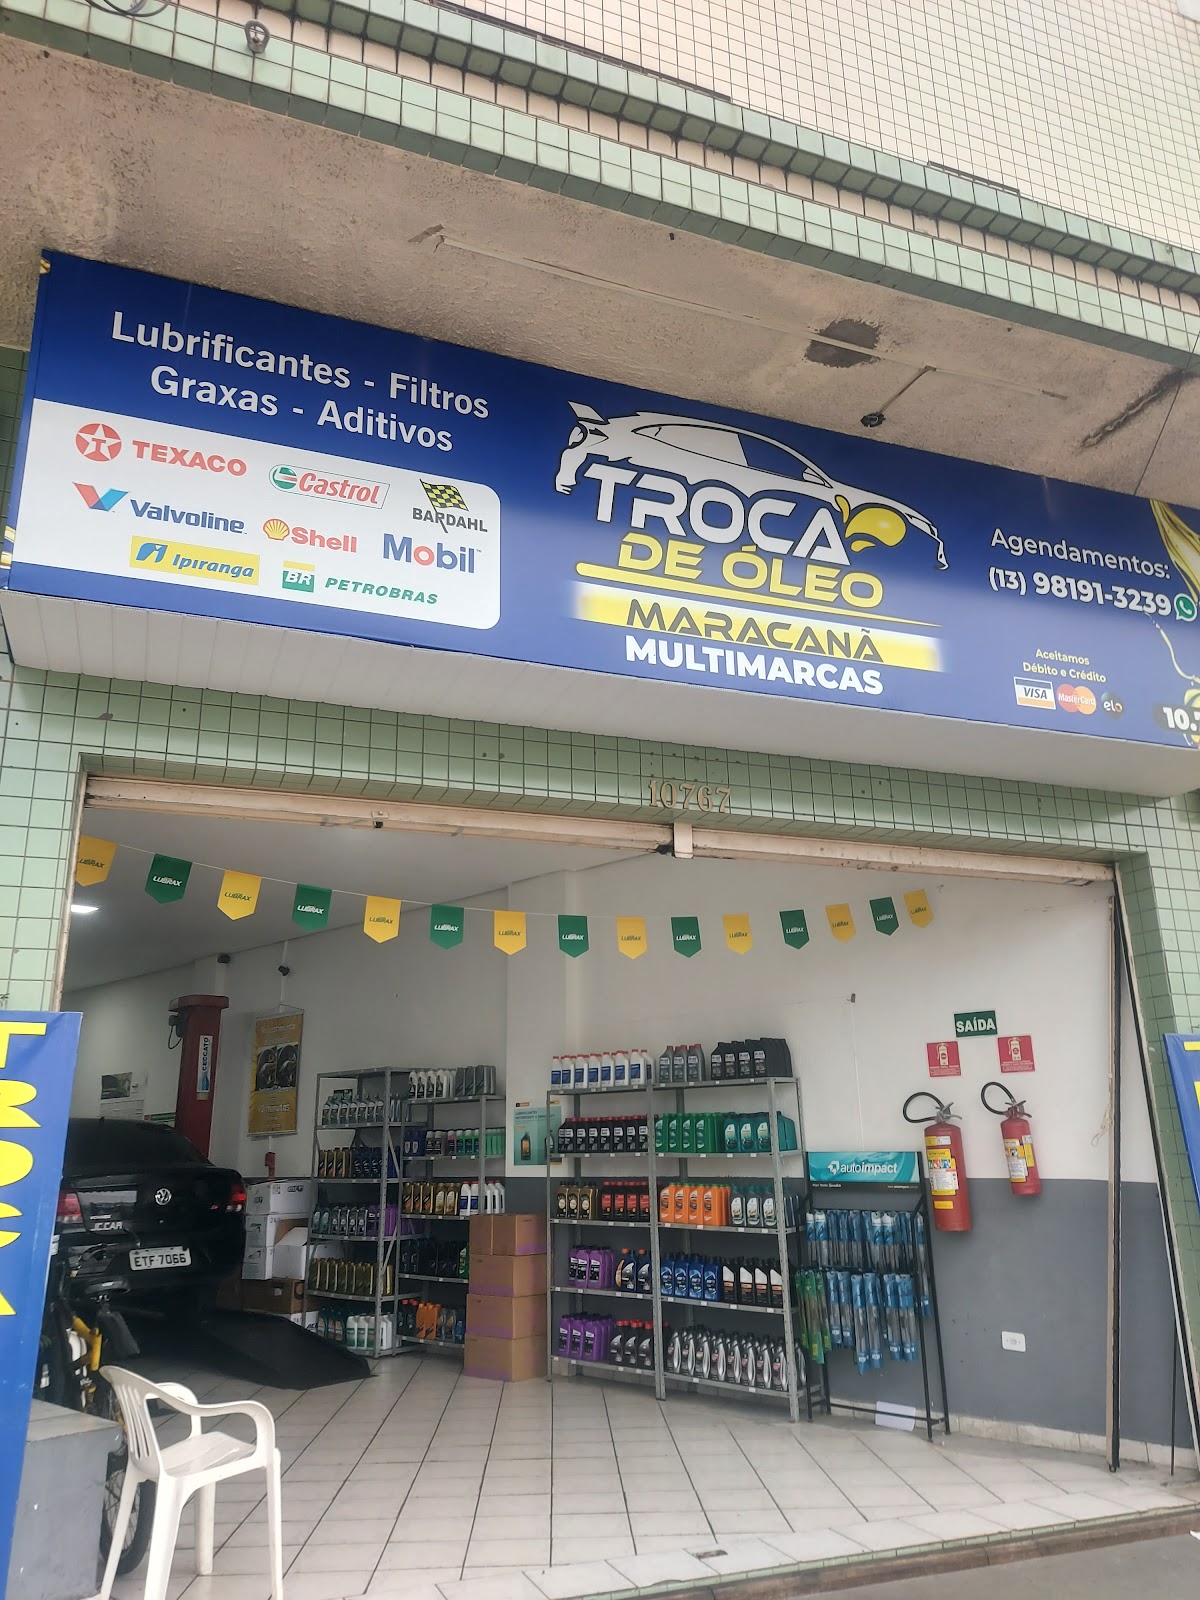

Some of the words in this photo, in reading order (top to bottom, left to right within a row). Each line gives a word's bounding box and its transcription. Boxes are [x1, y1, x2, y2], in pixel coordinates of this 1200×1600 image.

[111, 311, 352, 389] Lubrificantes
[388, 372, 490, 419] Filtros
[150, 365, 279, 416] Graxas
[316, 400, 454, 452] Aditivos
[132, 440, 247, 477] TEXACO
[298, 472, 383, 505] Castrol
[130, 499, 245, 535] Valvoline
[412, 507, 488, 533] BARDAHL
[584, 463, 851, 566] TROCA
[291, 526, 358, 554] Shell
[383, 533, 476, 574] Mobil
[172, 552, 254, 579] Ipiranga
[991, 528, 1171, 580] Agendamentos:
[284, 570, 314, 587] BR
[617, 532, 706, 580] DE
[721, 545, 884, 608] ÓLEO
[325, 577, 438, 605] PETROBRAS
[989, 566, 1027, 596] (13)
[1032, 571, 1172, 617] 98191-3239
[626, 598, 884, 662] MARACANÃ
[625, 635, 884, 696] MULTIMARCAS
[1035, 648, 1090, 666] Aceitamos
[1023, 662, 1058, 677] Débito
[1060, 669, 1067, 678] e
[1068, 667, 1107, 684] Crédito
[1022, 686, 1048, 701] VISA
[1057, 692, 1097, 706] MasterCard
[1103, 699, 1123, 713] elo
[648, 780, 731, 813] 10767
[152, 875, 182, 887] LUBRAX
[224, 891, 252, 902] LUBRAX
[297, 904, 325, 915] LUBRAX
[434, 923, 460, 932] LUBRAX
[562, 933, 585, 941] LUBRAX
[956, 1016, 996, 1033] SAÍDA
[840, 1162, 898, 1175] autoimpact
